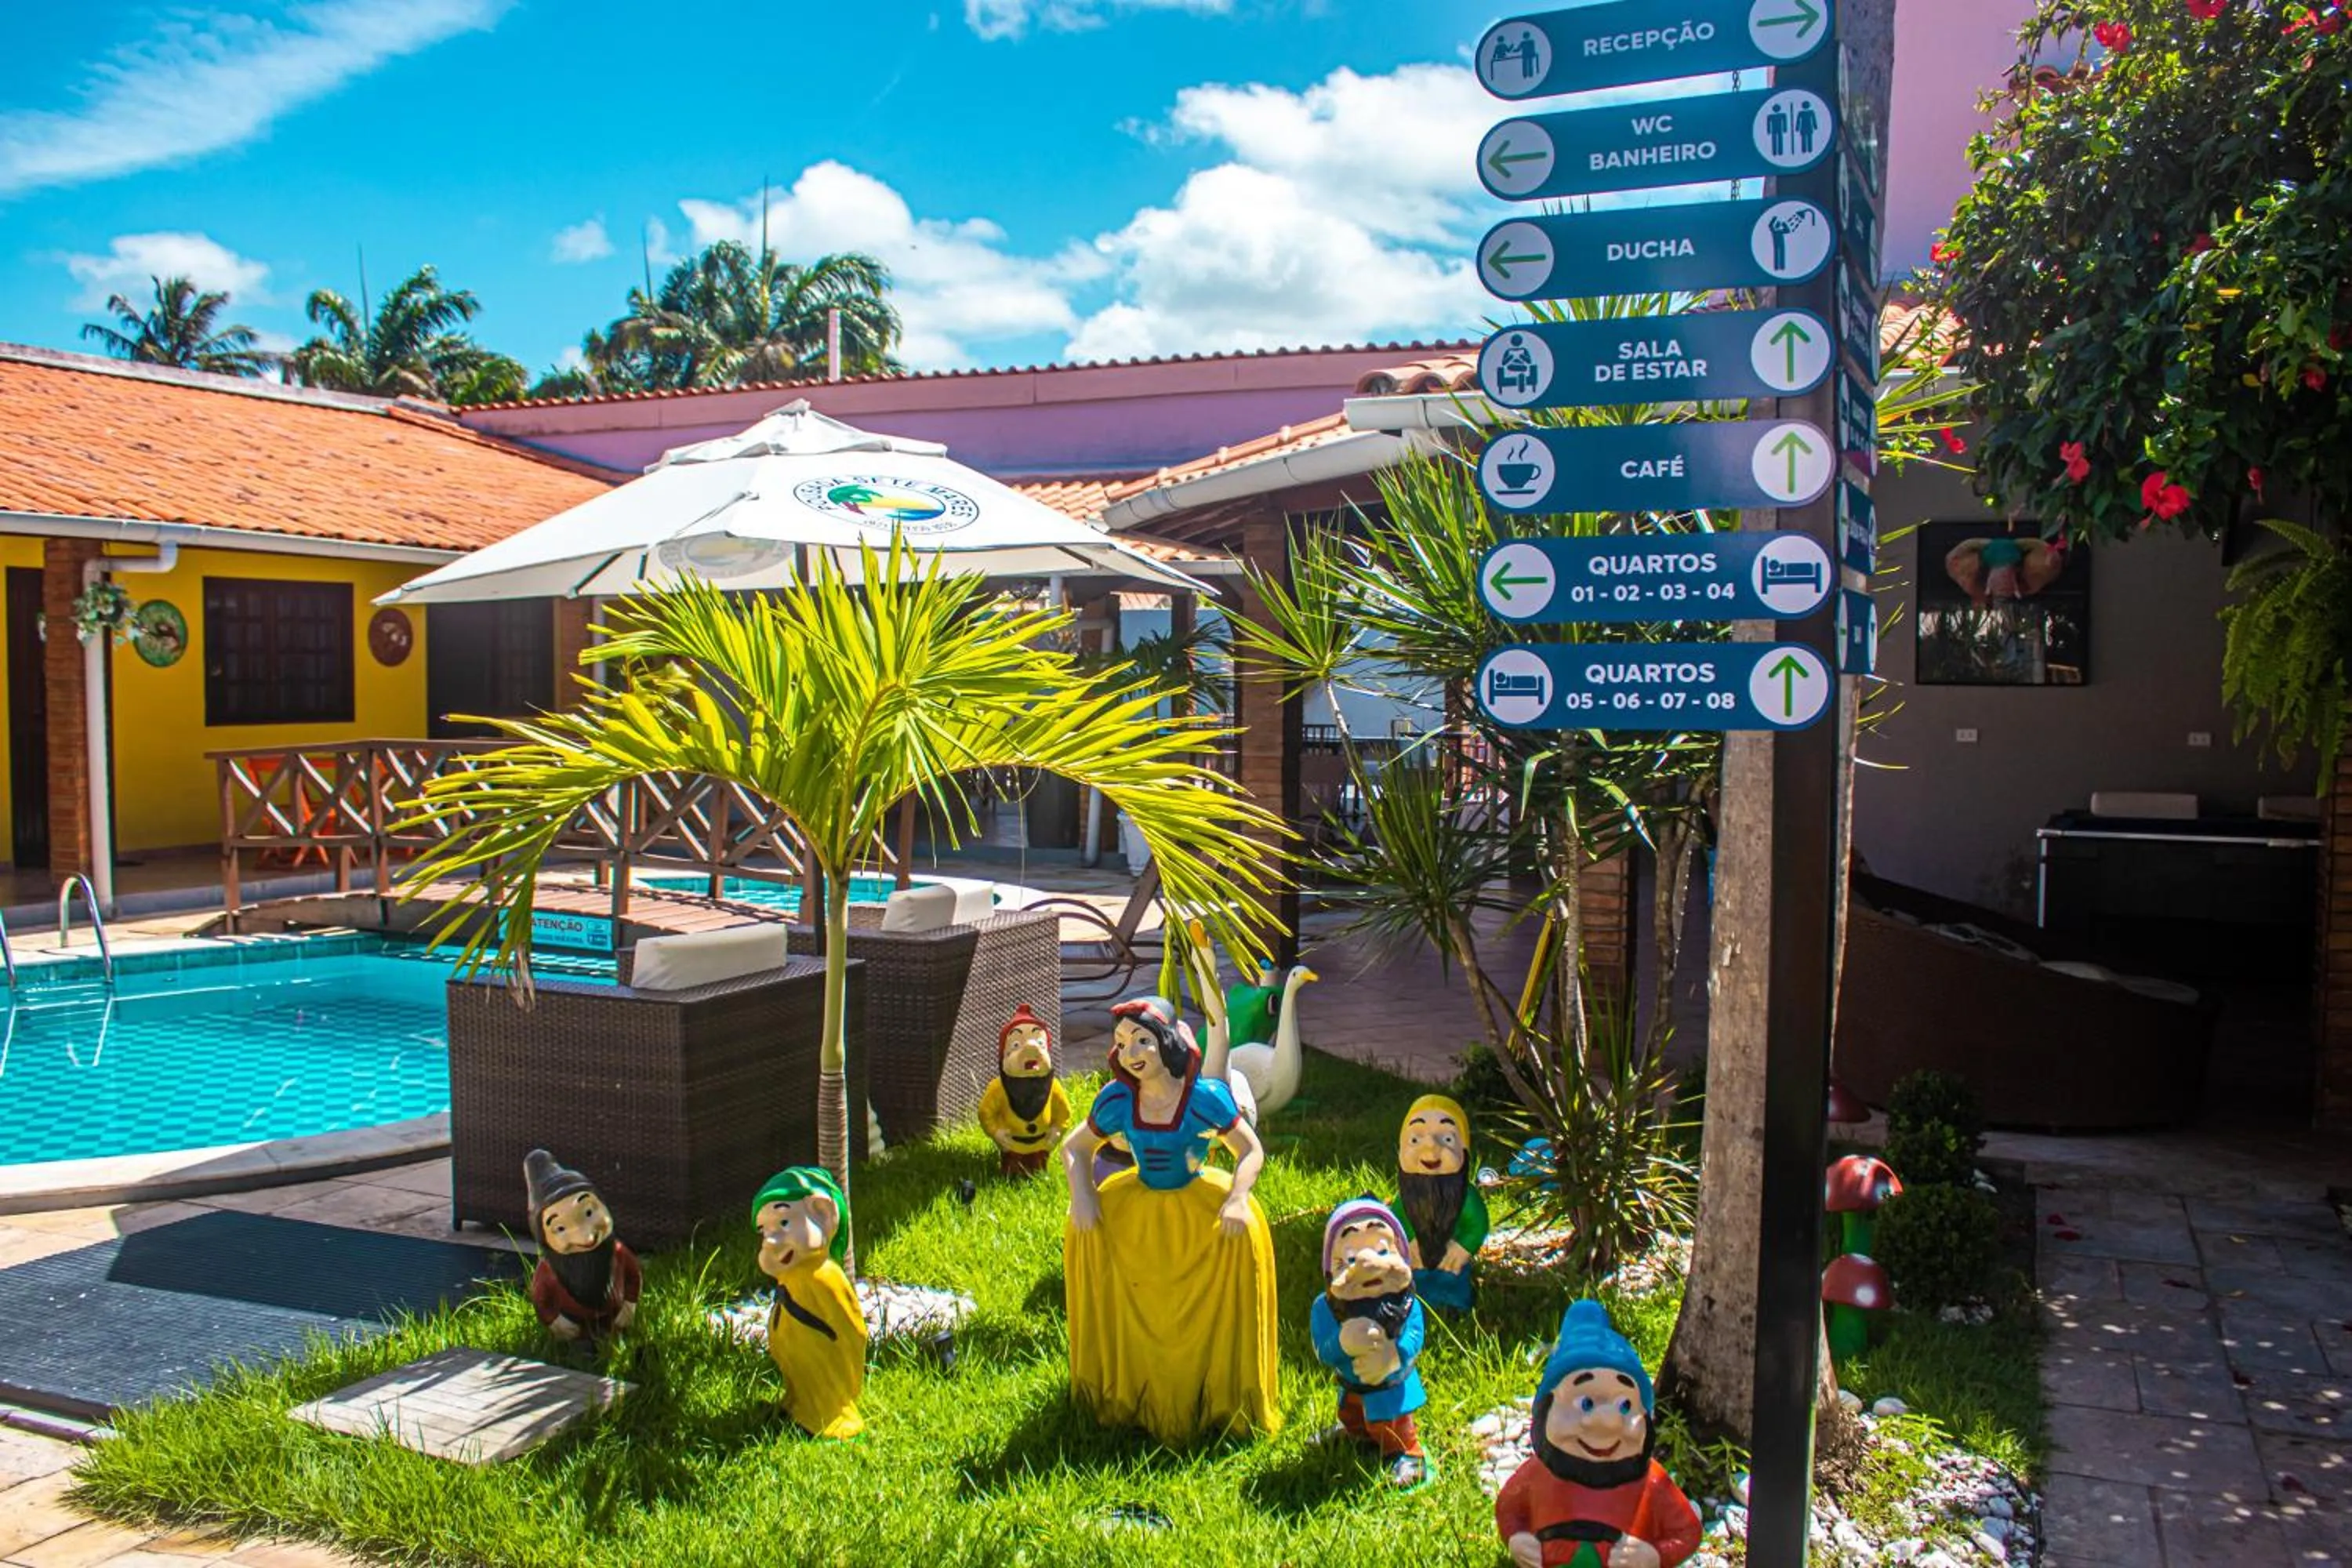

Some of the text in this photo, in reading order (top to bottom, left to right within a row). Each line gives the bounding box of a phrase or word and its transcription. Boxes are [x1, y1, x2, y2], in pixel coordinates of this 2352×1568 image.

[1583, 20, 1715, 56] RECEPÇÃO
[1631, 114, 1673, 136] WC
[1589, 141, 1717, 170] BANHEIRO
[1607, 238, 1695, 261] DUCHA
[1618, 339, 1682, 360] SALA
[1595, 358, 1708, 382] DE ESTAR
[1621, 454, 1684, 479] CAFÉ
[1588, 553, 1718, 576] QUARTOS
[1571, 586, 1594, 603] 01
[1613, 584, 1640, 601] 02
[1660, 583, 1687, 601] 03
[1707, 583, 1736, 600] 04
[1585, 662, 1716, 684] QUARTOS
[1566, 692, 1594, 710] 05
[1613, 692, 1641, 710] 06
[1660, 691, 1686, 710] 07
[1706, 691, 1736, 710] 08
